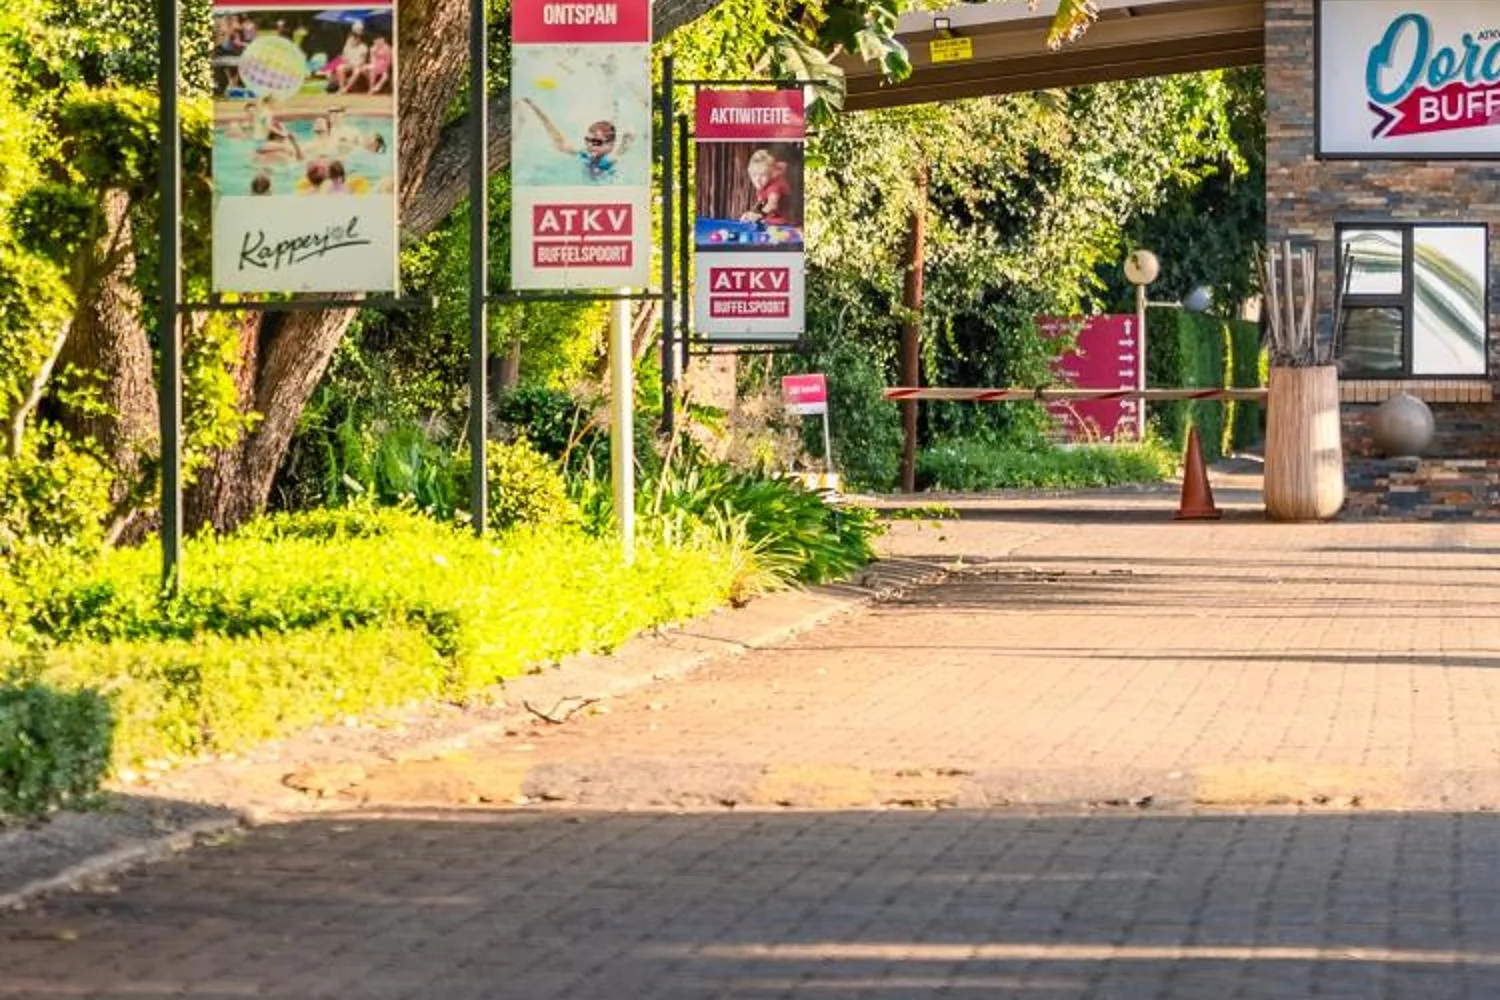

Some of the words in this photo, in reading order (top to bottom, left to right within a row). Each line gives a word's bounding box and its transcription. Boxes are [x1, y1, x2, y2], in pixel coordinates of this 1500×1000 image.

[543, 3, 618, 25] ONTSPAN
[538, 208, 628, 231] ATKV
[537, 245, 629, 263] BUFFELSPOORT
[714, 271, 786, 289] ATKV
